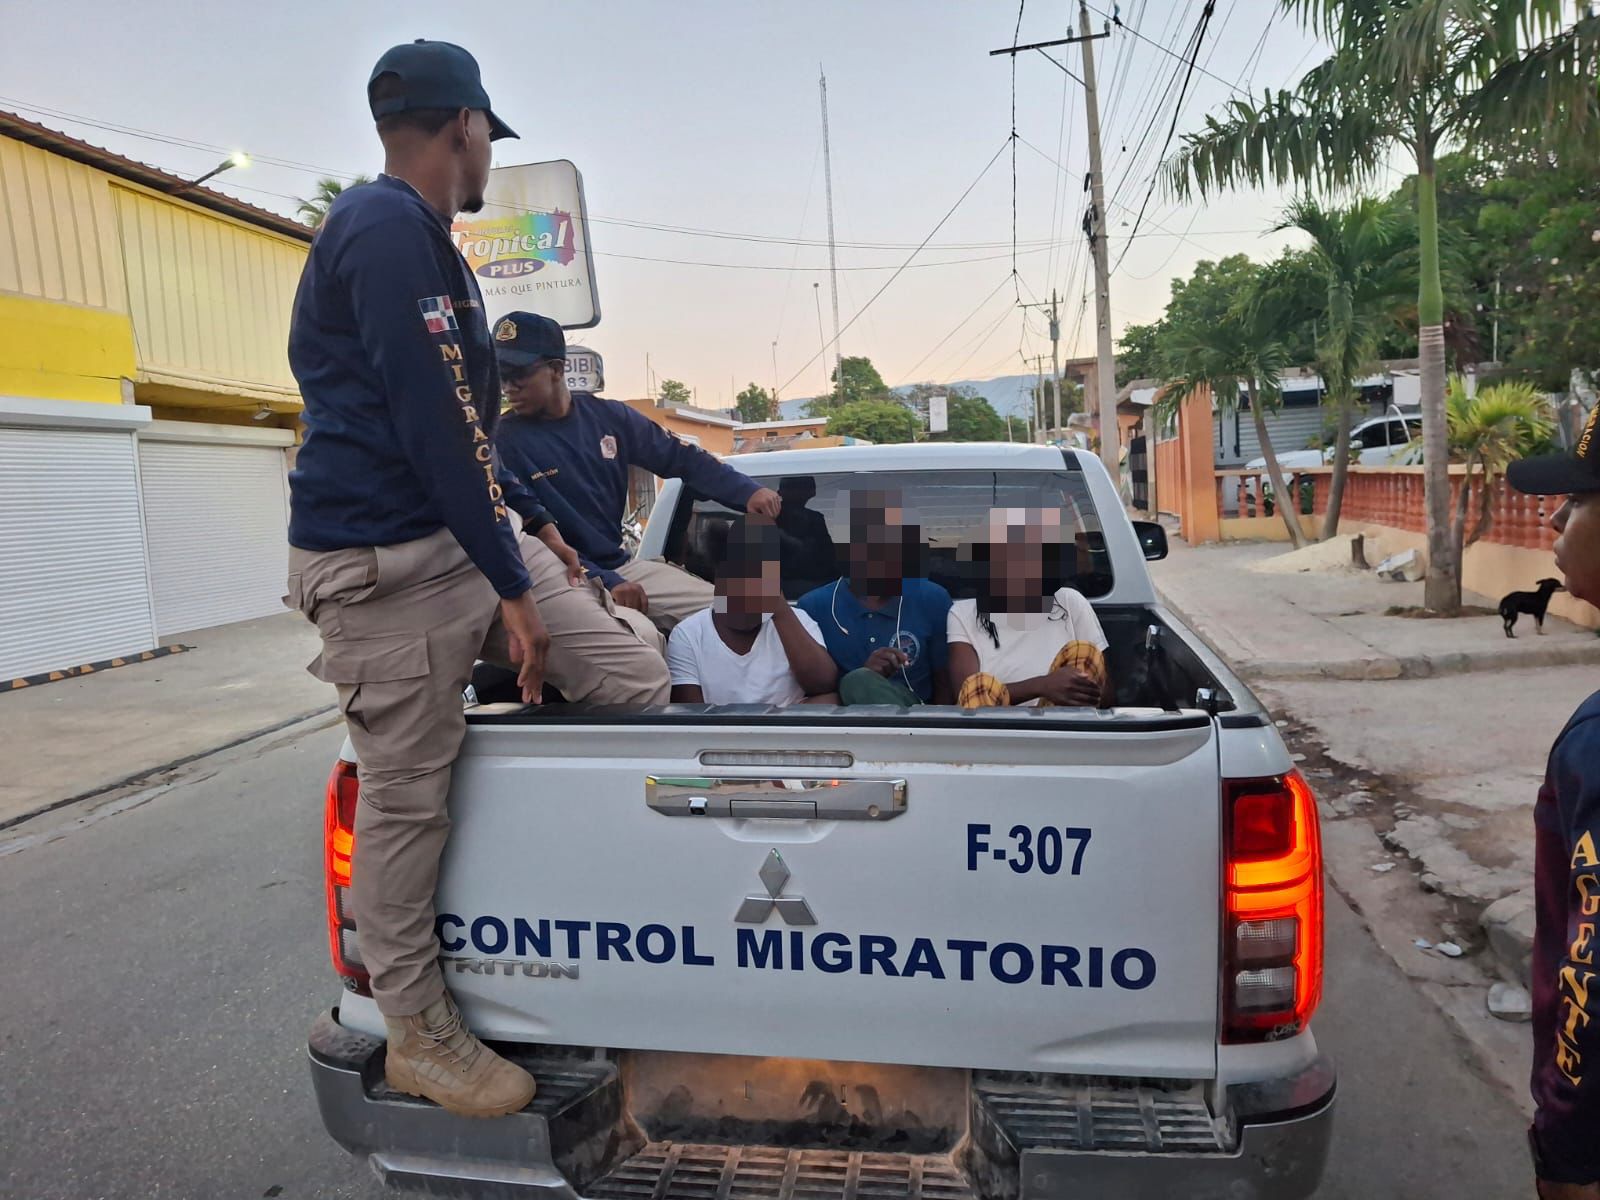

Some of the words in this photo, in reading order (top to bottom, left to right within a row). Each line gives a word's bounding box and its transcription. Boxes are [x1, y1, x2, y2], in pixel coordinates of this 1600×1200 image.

[490, 261, 535, 277] PLUS
[511, 283, 533, 296] QUE
[535, 278, 582, 291] PINTURA
[967, 823, 1092, 876] F-307
[435, 913, 715, 967] CONTROL
[736, 928, 1157, 990] MIGRATORIO
[1556, 829, 1600, 1087] AGENTE
